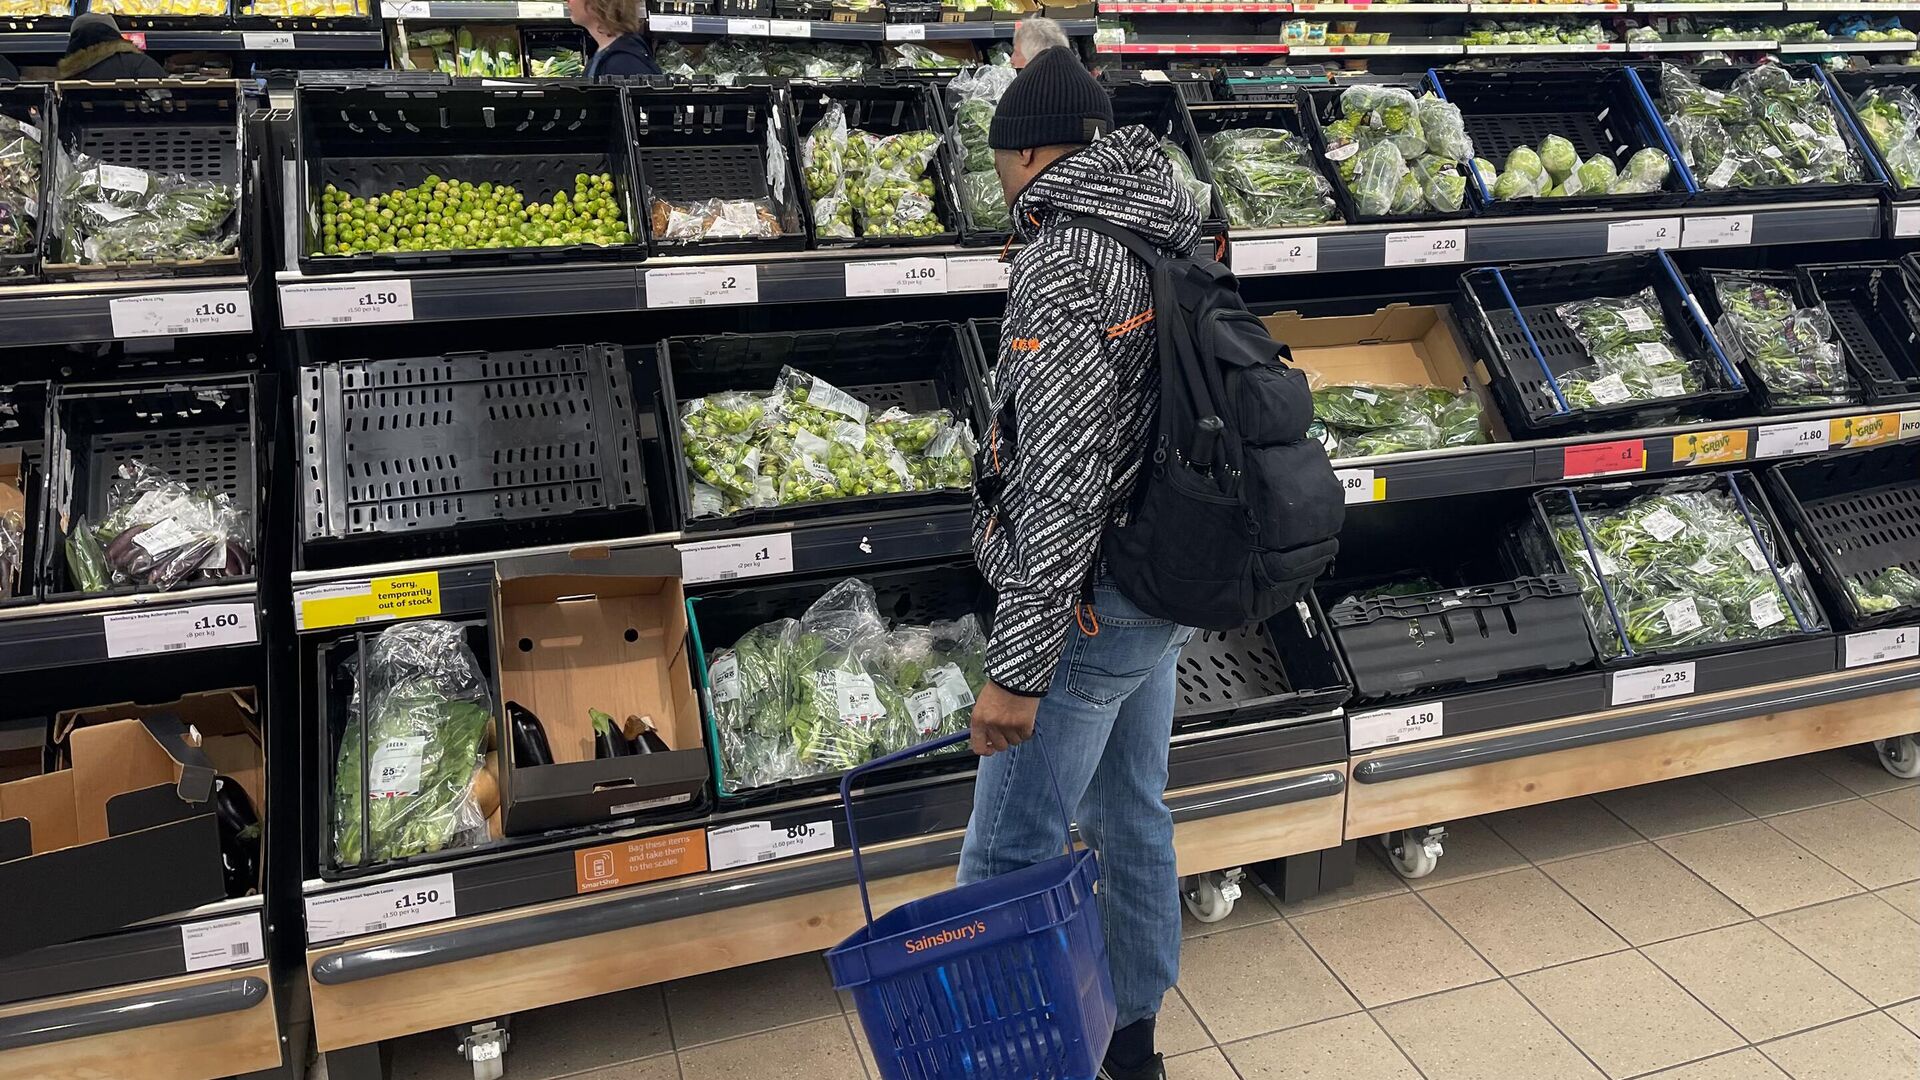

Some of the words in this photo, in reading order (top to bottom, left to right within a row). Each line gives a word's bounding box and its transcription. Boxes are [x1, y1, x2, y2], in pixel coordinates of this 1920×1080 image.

[1656, 228, 1666, 238] £2
[1730, 222, 1740, 232] £2
[1290, 246, 1301, 256] £2
[1432, 240, 1456, 250] £2.20
[906, 268, 935, 279] £1.60
[721, 277, 736, 289] £2
[360, 292, 397, 306] £1.50
[196, 302, 237, 315] £1.60
[1800, 430, 1822, 441] £1.80
[1622, 448, 1632, 459] £1
[1341, 478, 1361, 488] .80
[755, 548, 770, 560] £1
[391, 581, 417, 590] Sorry,
[378, 588, 432, 600] temporarily
[408, 597, 432, 606] stock
[194, 614, 238, 629] £1.60
[1896, 633, 1905, 644] £1
[1661, 672, 1686, 684] £2.35
[1406, 713, 1433, 726] £1.50
[787, 824, 815, 838] 80p
[628, 844, 643, 853] Bag
[646, 841, 666, 849] these
[668, 836, 690, 845] items
[629, 853, 643, 862] and
[646, 850, 663, 860] take
[666, 846, 686, 856] them
[640, 862, 653, 871] the
[654, 858, 678, 867] scales
[582, 878, 619, 889] SmartShop
[395, 890, 439, 909] £1.50
[906, 920, 986, 954] Sainsbury's
